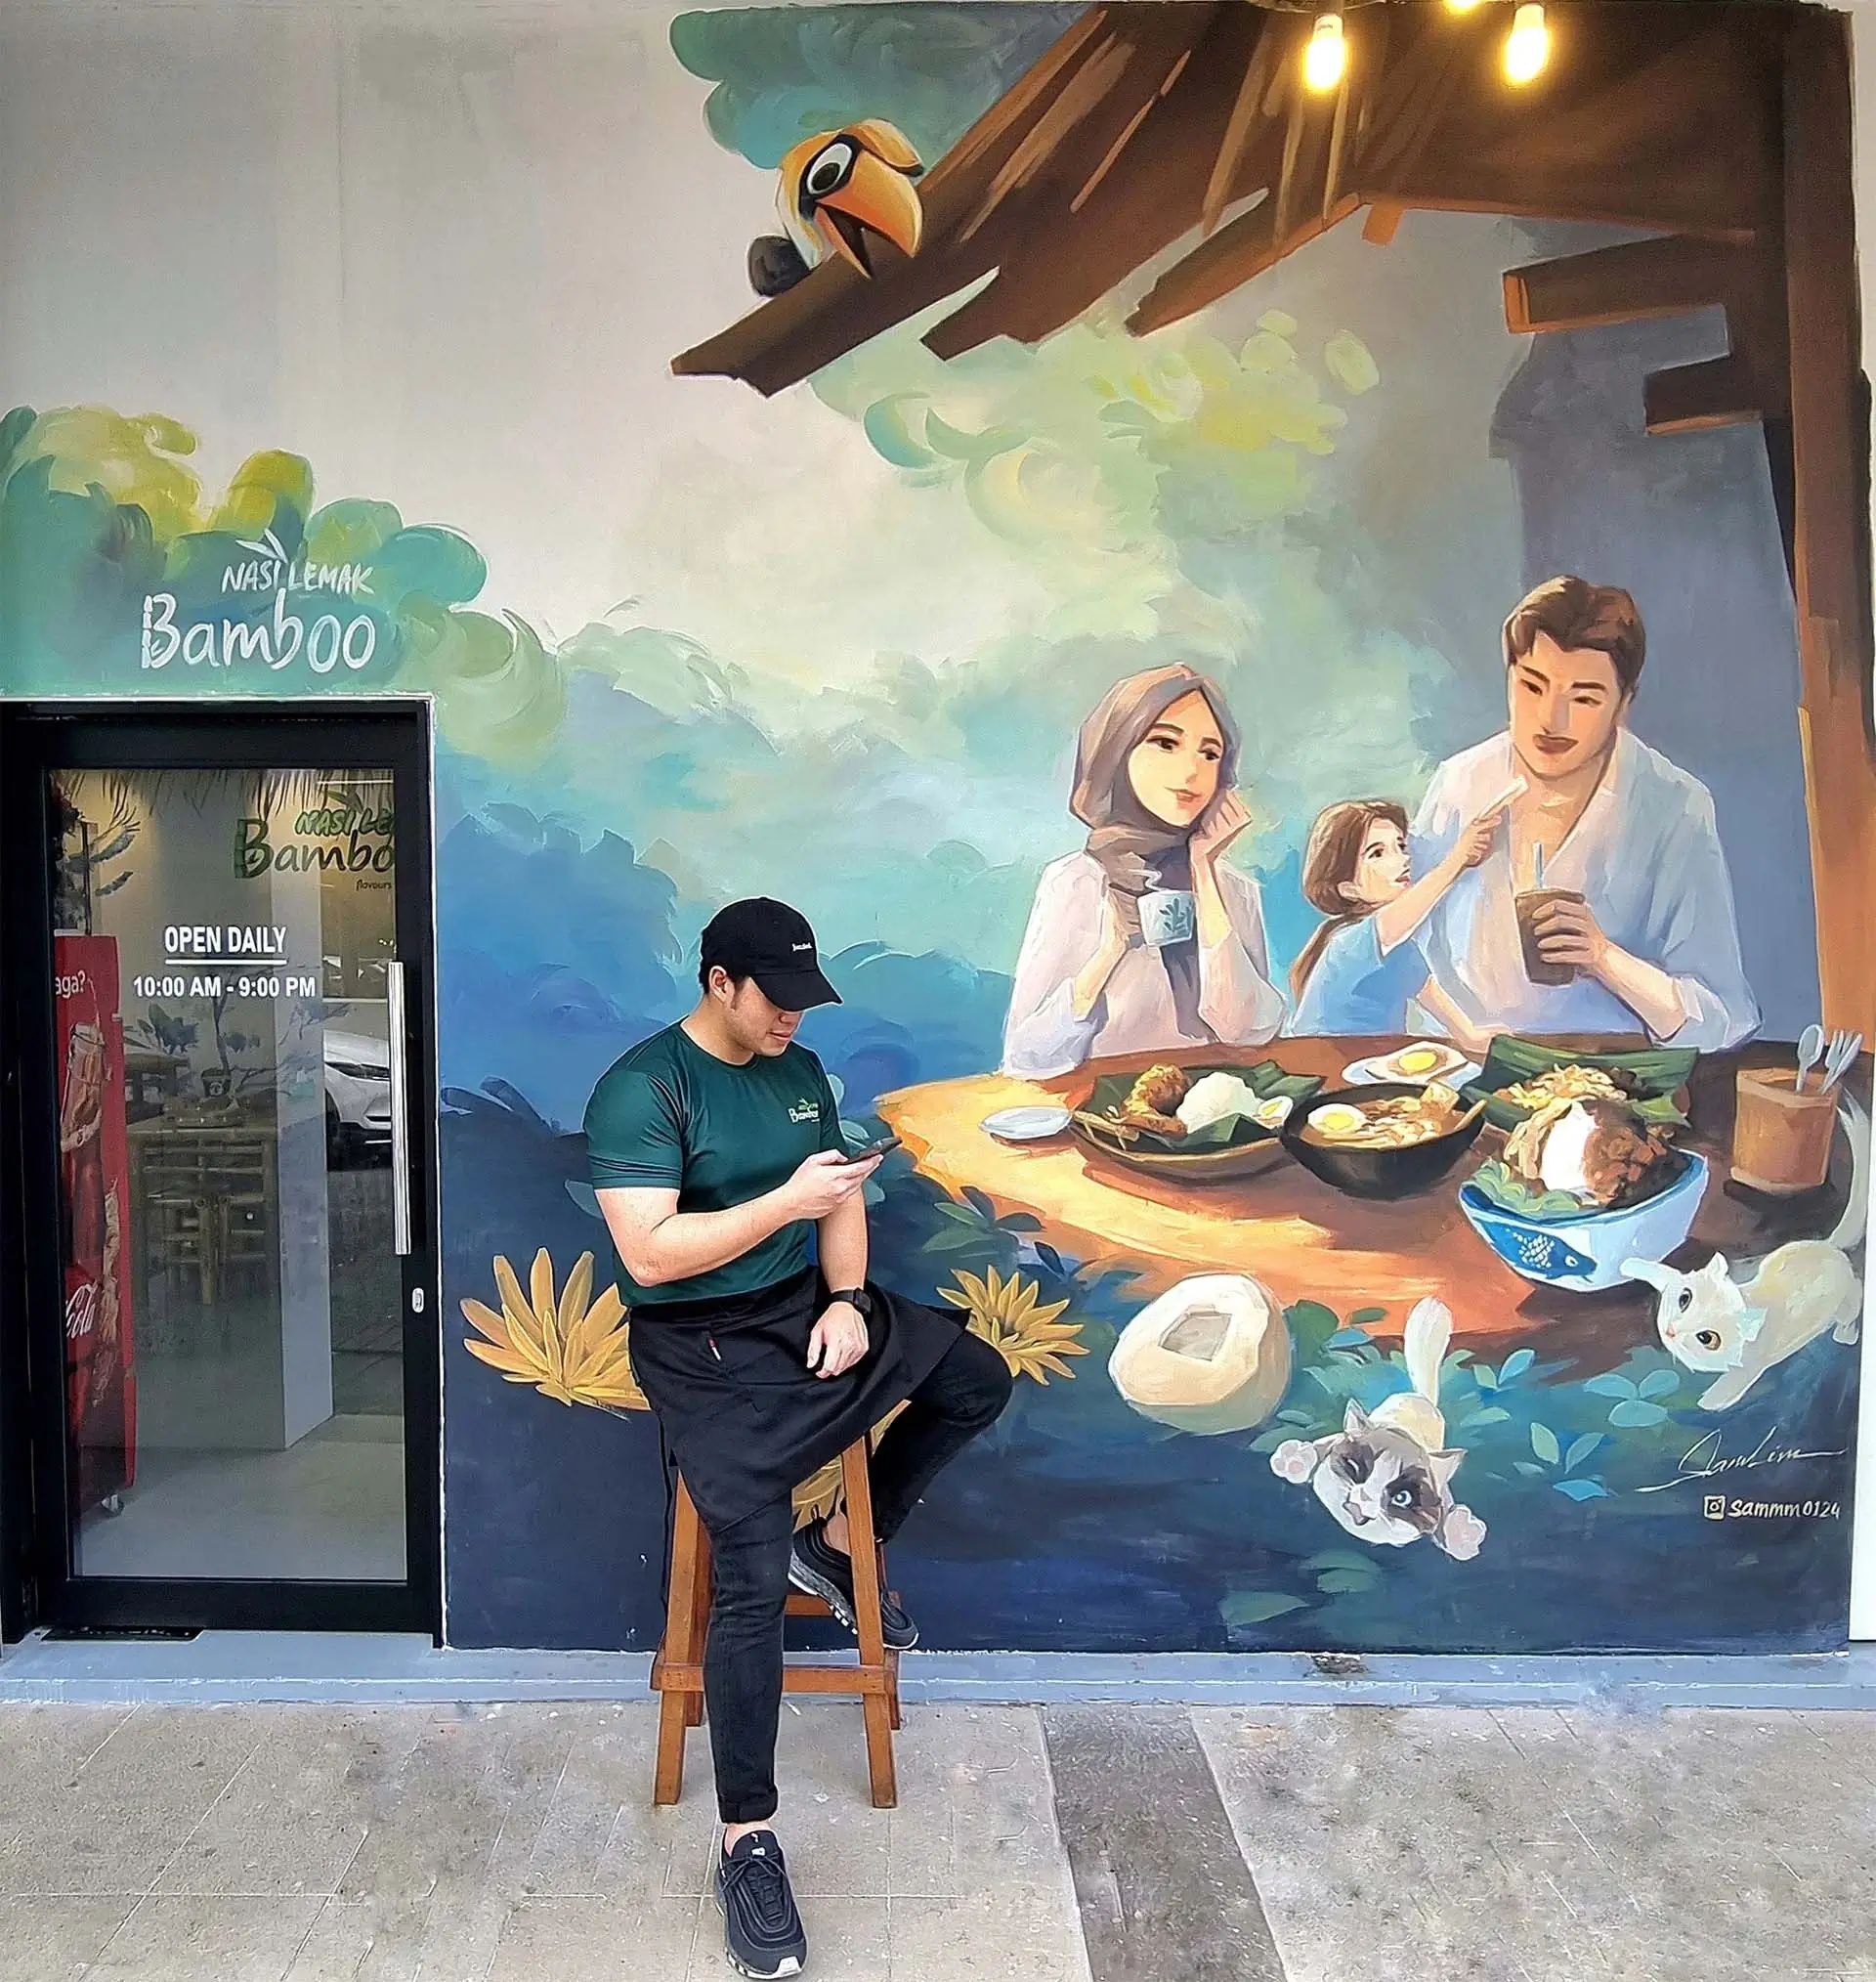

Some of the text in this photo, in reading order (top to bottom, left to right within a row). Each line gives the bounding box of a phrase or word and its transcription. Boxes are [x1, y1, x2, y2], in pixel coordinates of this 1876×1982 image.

[221, 560, 375, 594] NASI LEMAK
[142, 587, 375, 672] Bamboo
[294, 808, 357, 837] NASI
[164, 926, 286, 953] OPEN DAILY
[133, 976, 185, 997] 10:00
[190, 976, 222, 997] AM
[239, 976, 280, 997] 9:00
[285, 976, 316, 997] PM
